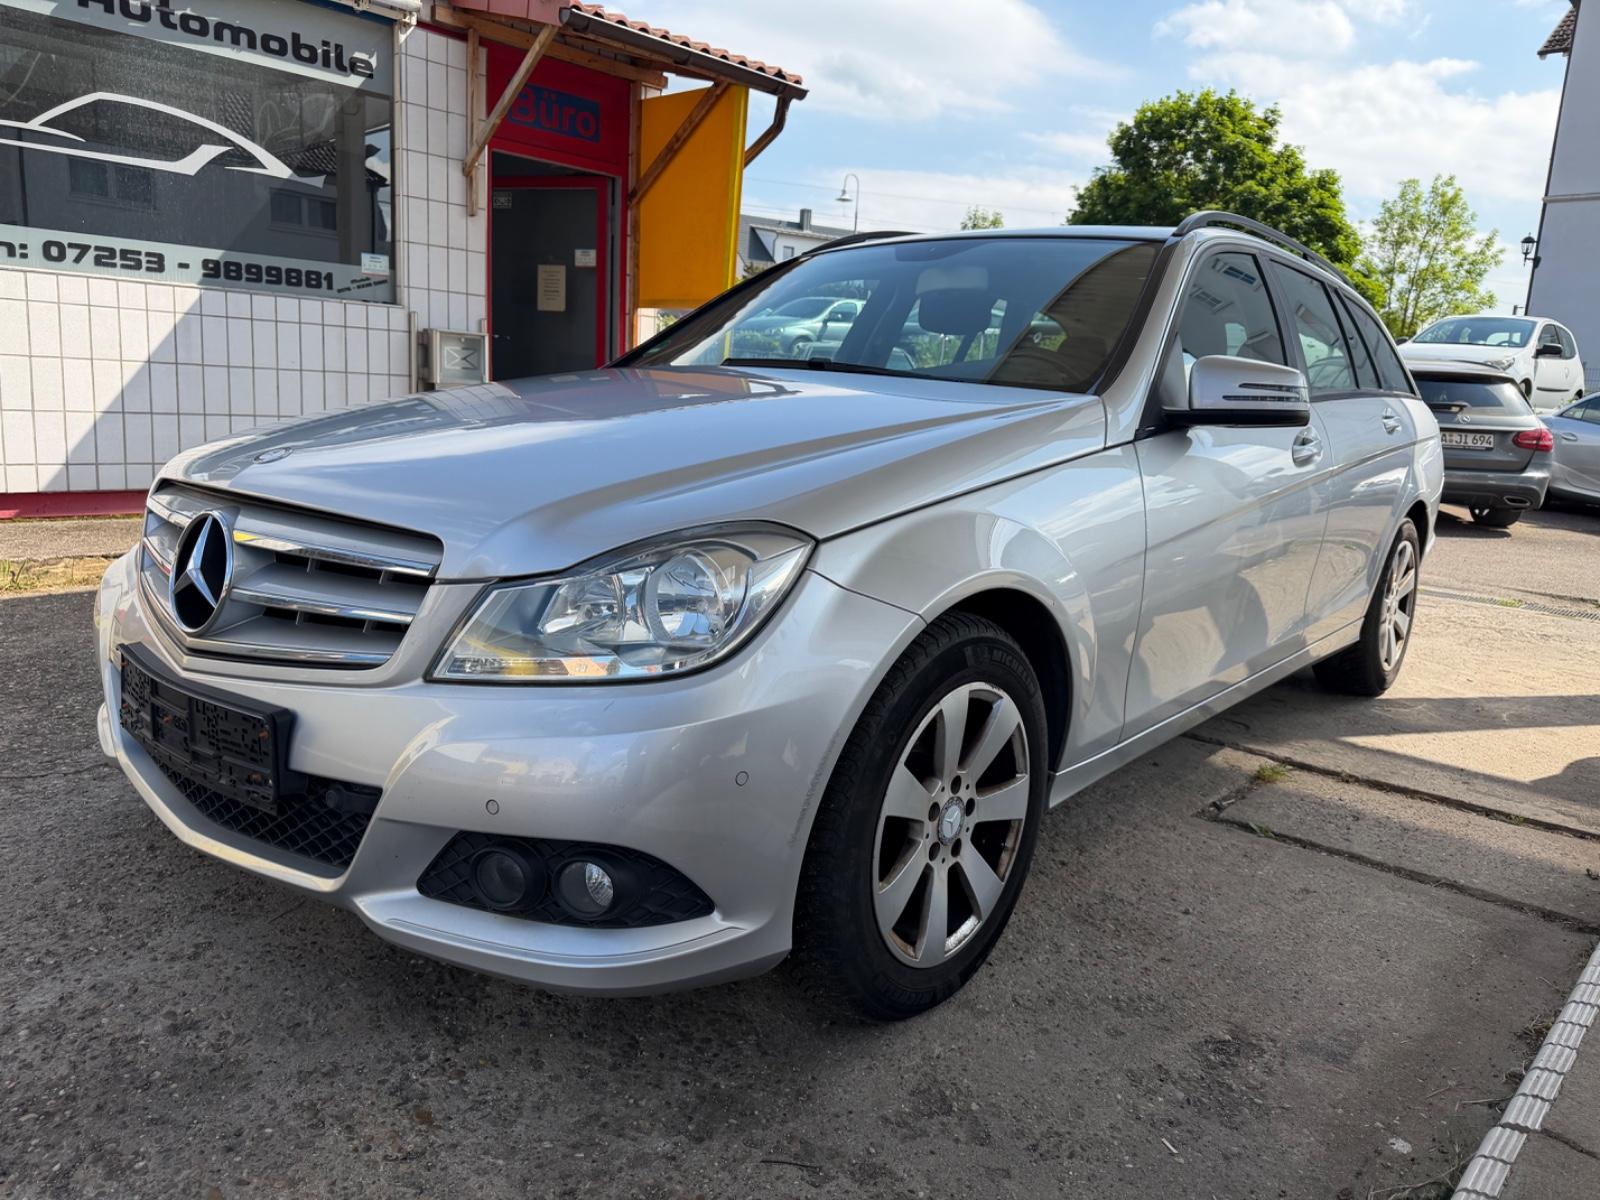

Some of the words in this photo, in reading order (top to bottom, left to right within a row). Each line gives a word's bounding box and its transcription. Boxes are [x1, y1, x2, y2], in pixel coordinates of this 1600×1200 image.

[511, 87, 596, 136] Büro
[42, 240, 165, 273] 07253
[202, 258, 333, 290] 9899881
[1471, 434, 1492, 446] 694
